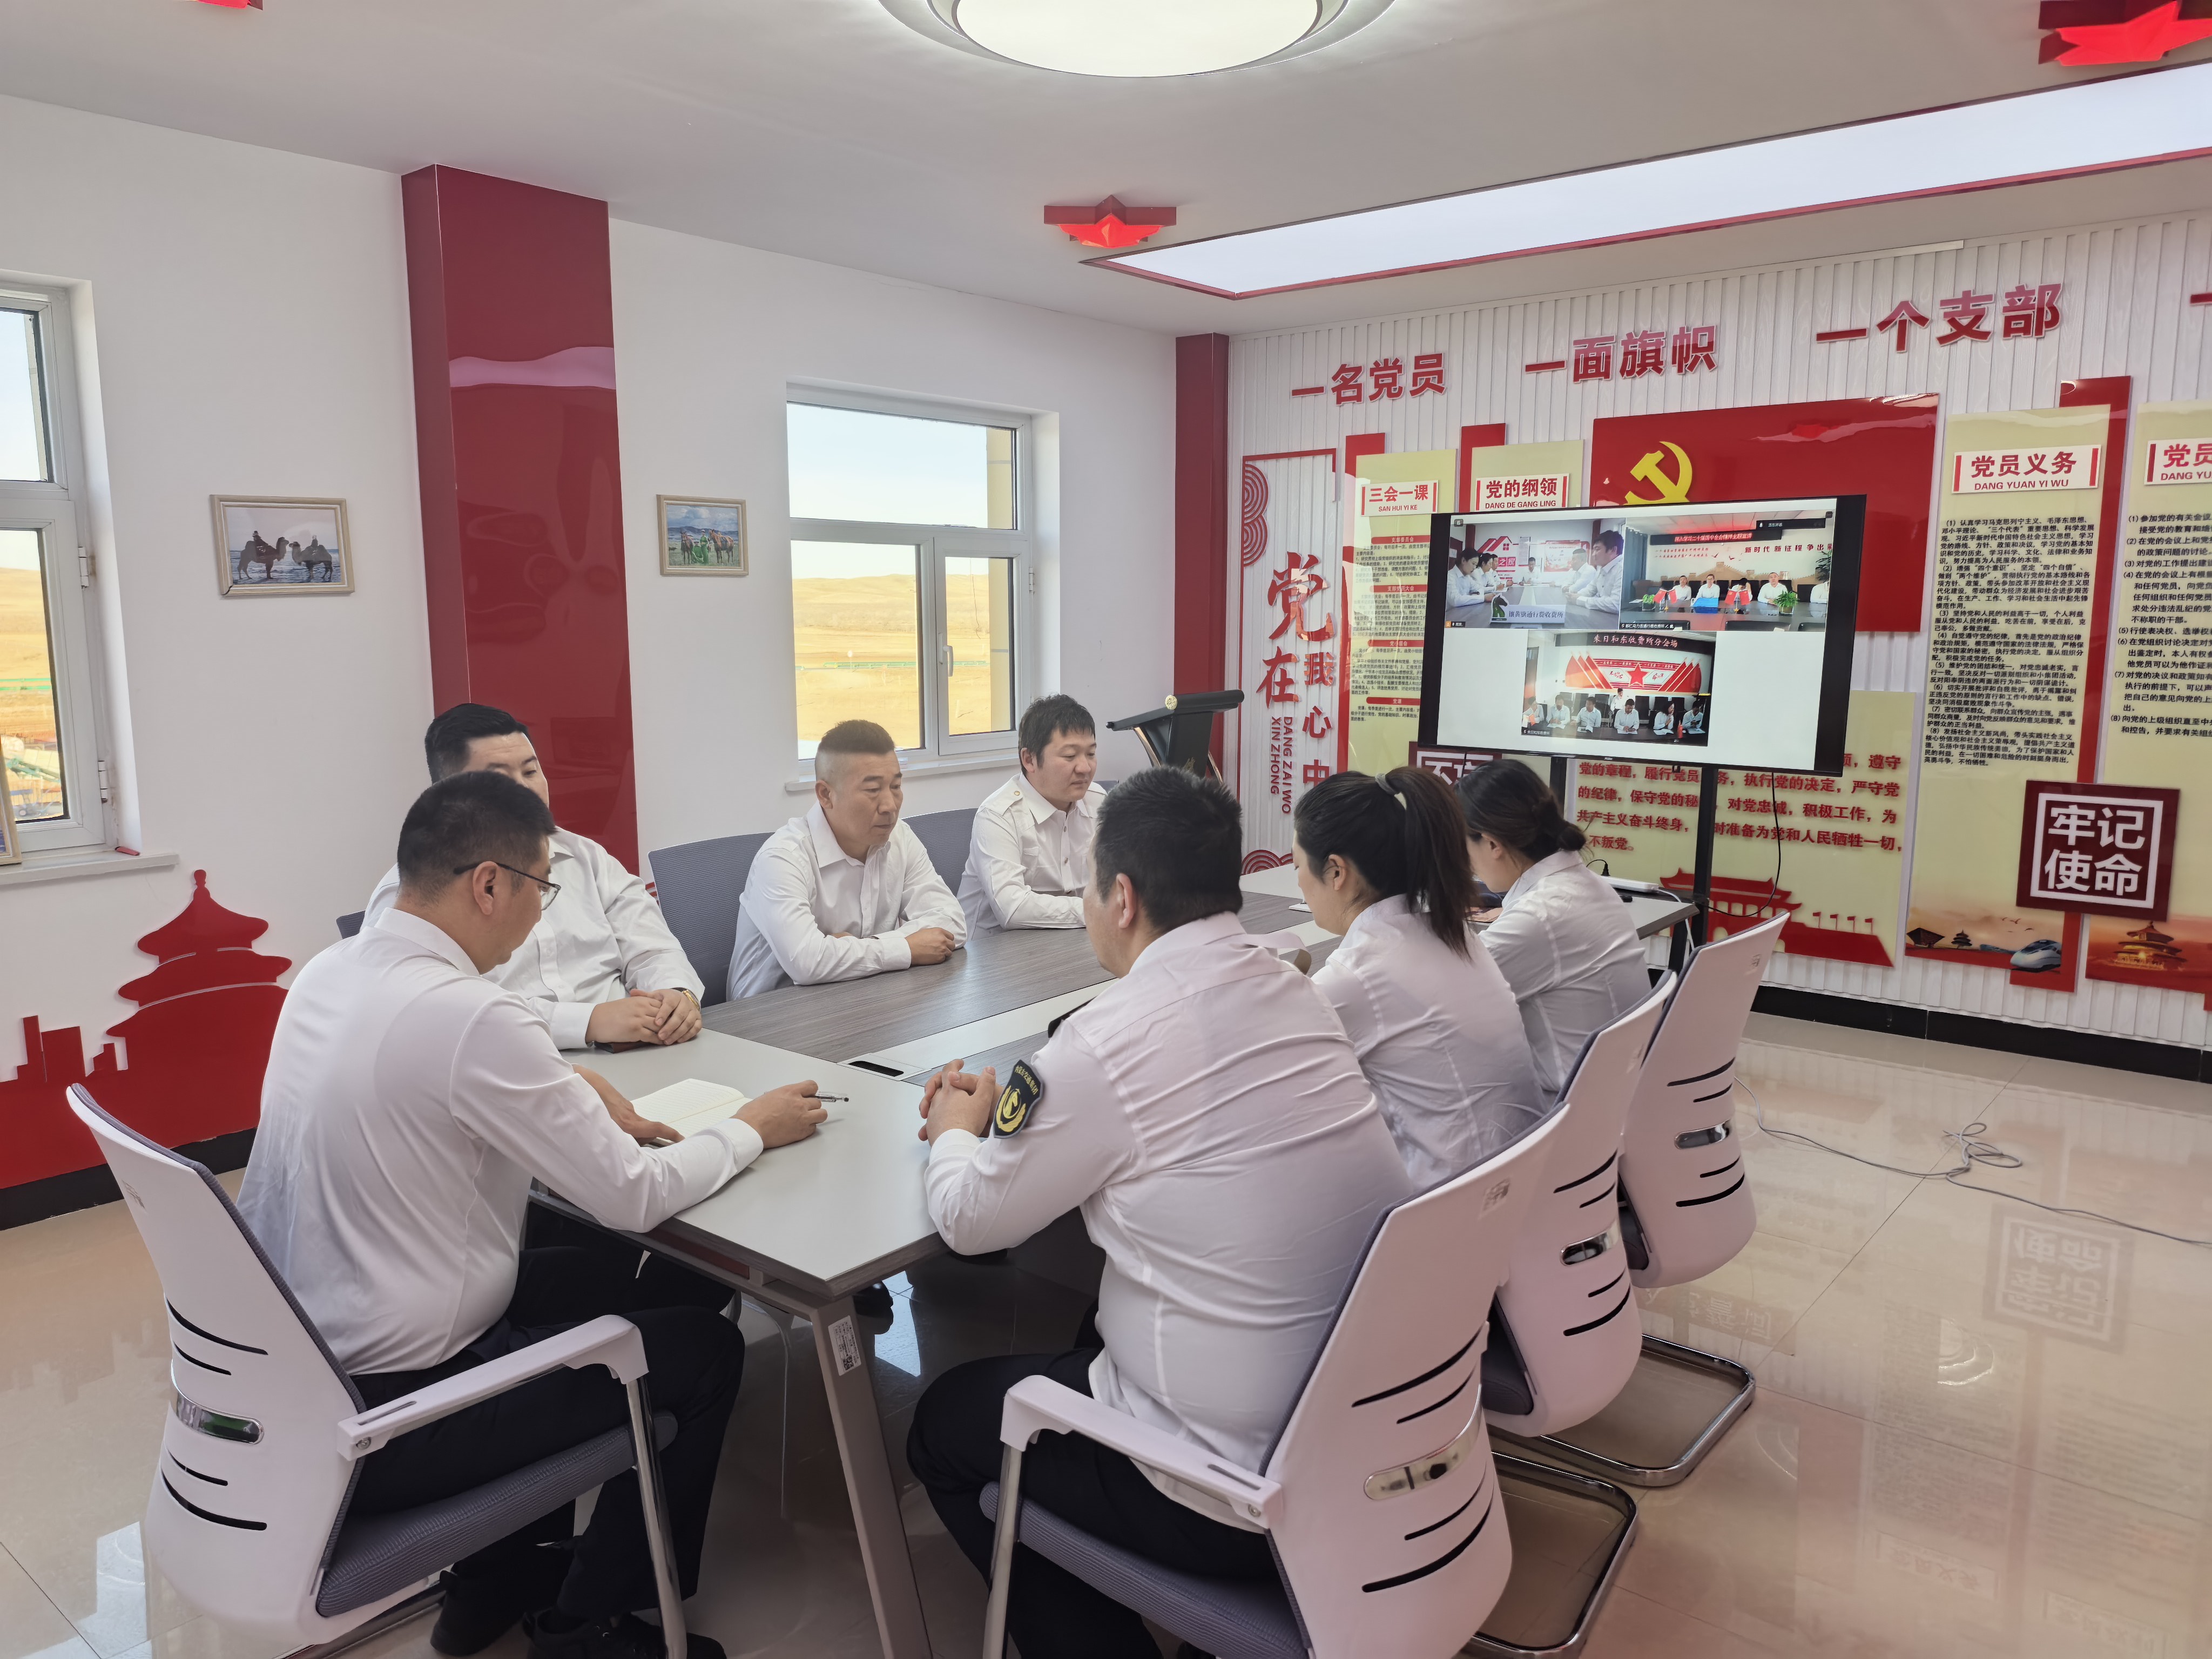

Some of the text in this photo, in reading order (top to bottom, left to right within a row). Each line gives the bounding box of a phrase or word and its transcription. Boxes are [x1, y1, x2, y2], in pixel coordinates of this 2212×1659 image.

[1816, 283, 2062, 353] 一个支部
[1525, 325, 1718, 383] 一面旗帜
[1292, 353, 1446, 406] 一名党员
[1971, 451, 2077, 478] 党员义务
[2161, 471, 2212, 481] DANG YU
[1369, 484, 1428, 503] 三会一课
[1486, 477, 1557, 499] 党的纲领
[1974, 482, 2004, 490] DANG
[2007, 481, 2035, 489] YUAN
[2119, 627, 2212, 635] (5)行使表决权、选举权
[2124, 693, 2212, 703] 把自己的意见向党的上
[1270, 717, 1281, 795] XIN ZHONG
[1282, 717, 1293, 814] DANG ZAI WO
[2048, 805, 2145, 848] 牢记
[1589, 835, 1634, 852] 不叛党。
[2045, 849, 2142, 895] 使命
